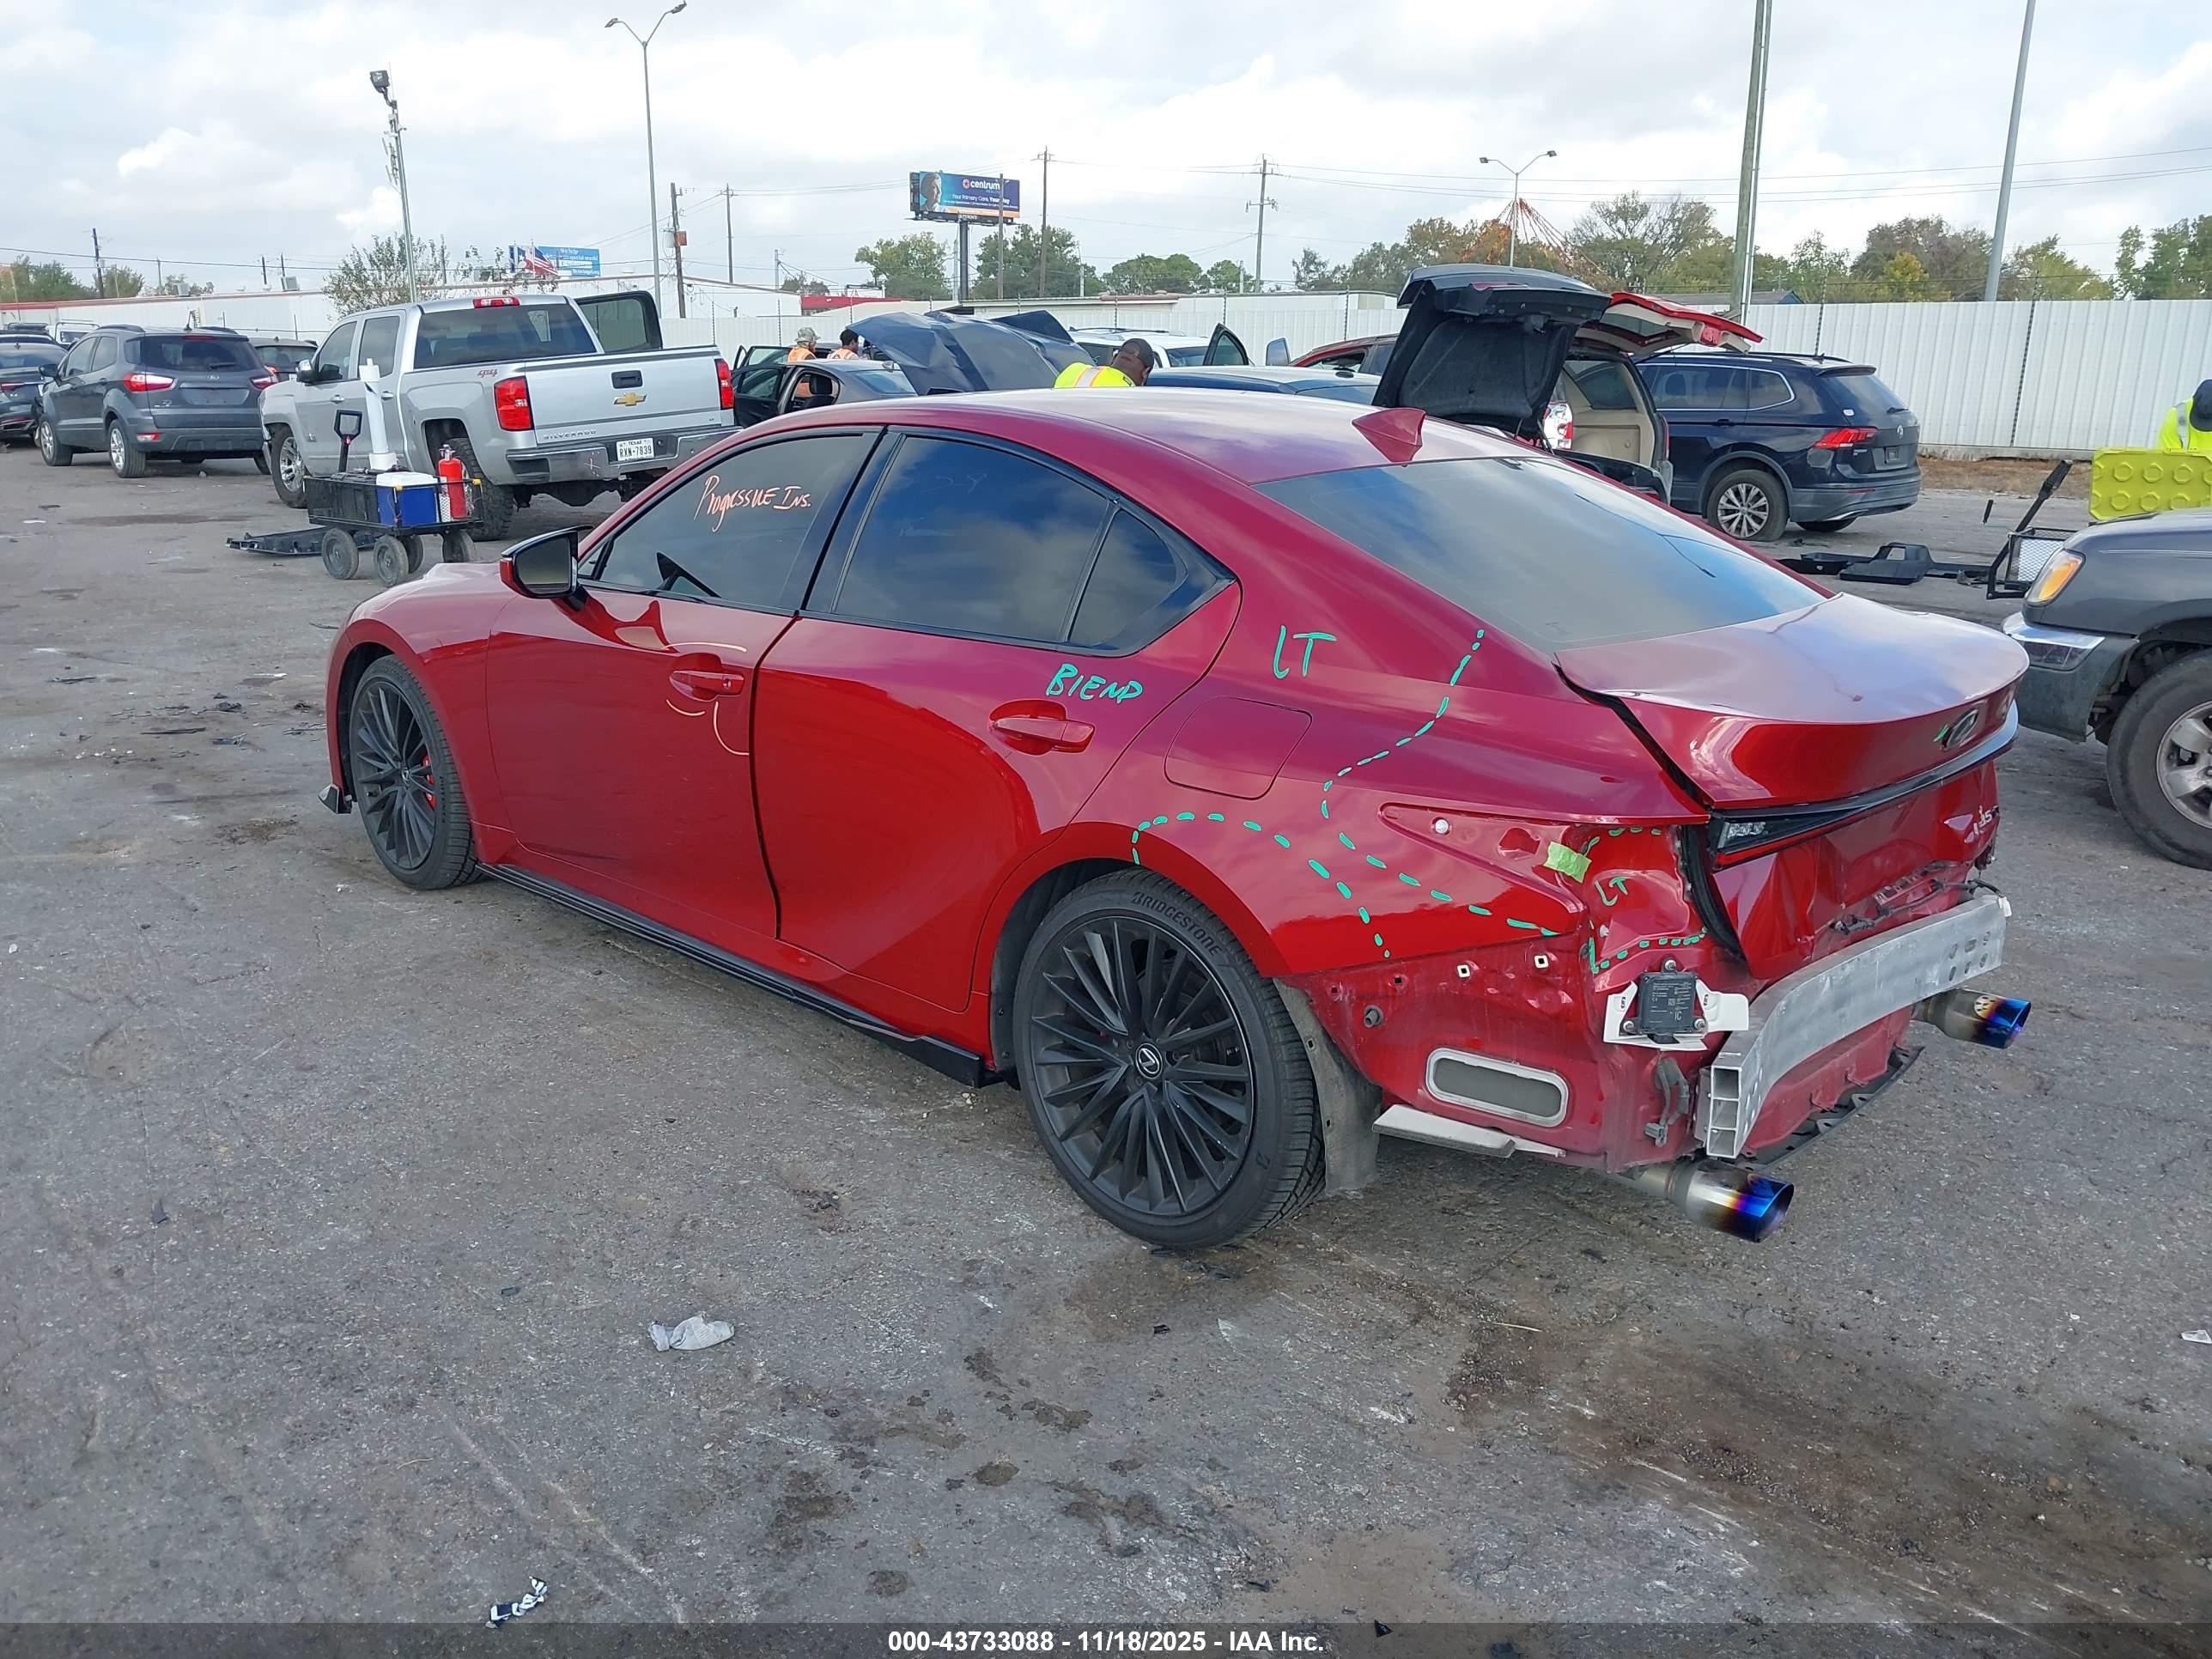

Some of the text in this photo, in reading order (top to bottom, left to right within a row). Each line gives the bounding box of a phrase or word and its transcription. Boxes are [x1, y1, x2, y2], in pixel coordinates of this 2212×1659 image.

[970, 180, 1000, 190] centrum
[1273, 624, 1338, 680] LT
[1595, 876, 1631, 908] LT
[1131, 891, 1223, 957] BRIDGESTONE
